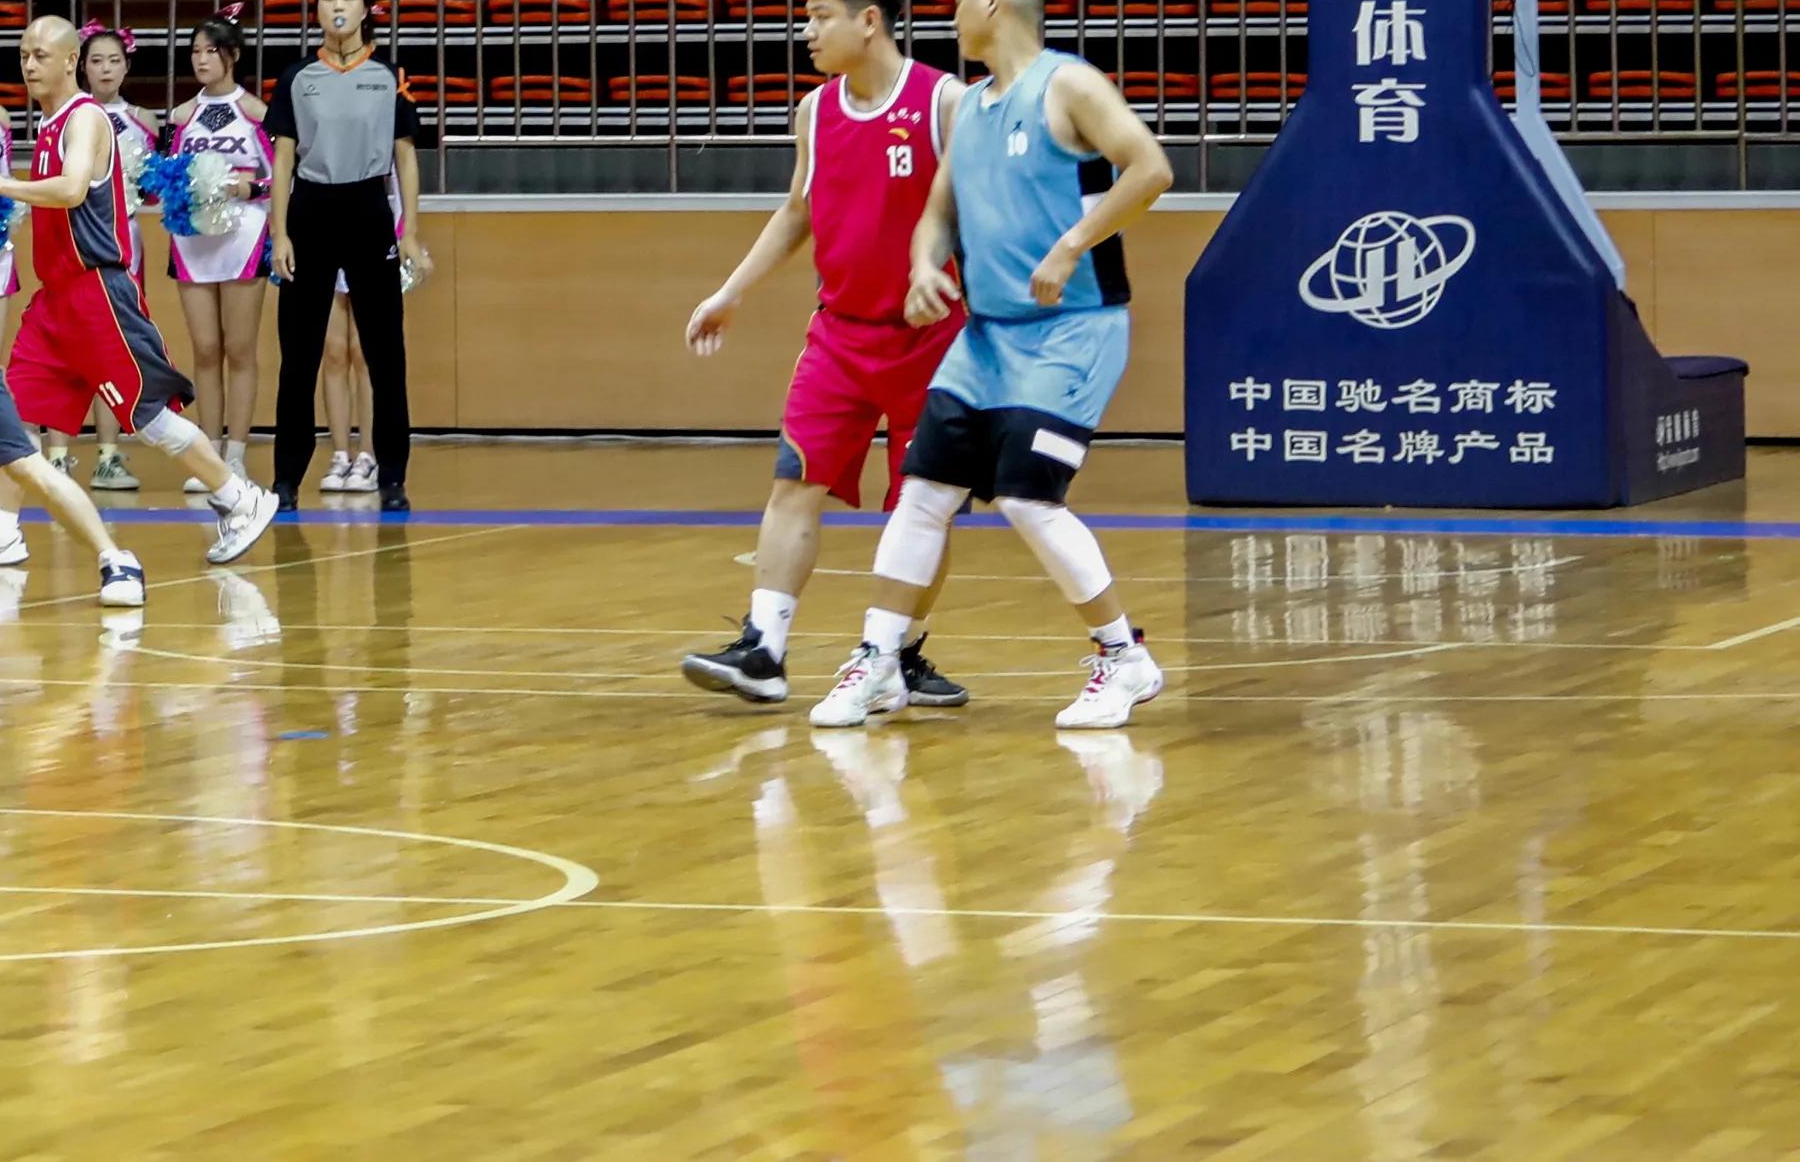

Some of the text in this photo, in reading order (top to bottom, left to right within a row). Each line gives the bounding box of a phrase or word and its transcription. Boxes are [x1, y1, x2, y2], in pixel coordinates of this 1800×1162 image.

[38, 150, 50, 176] 11
[885, 144, 914, 178] 13
[98, 380, 125, 408] 11
[1228, 375, 1558, 415] 中国驰名商标
[1230, 427, 1556, 466] 中国名牌产品
